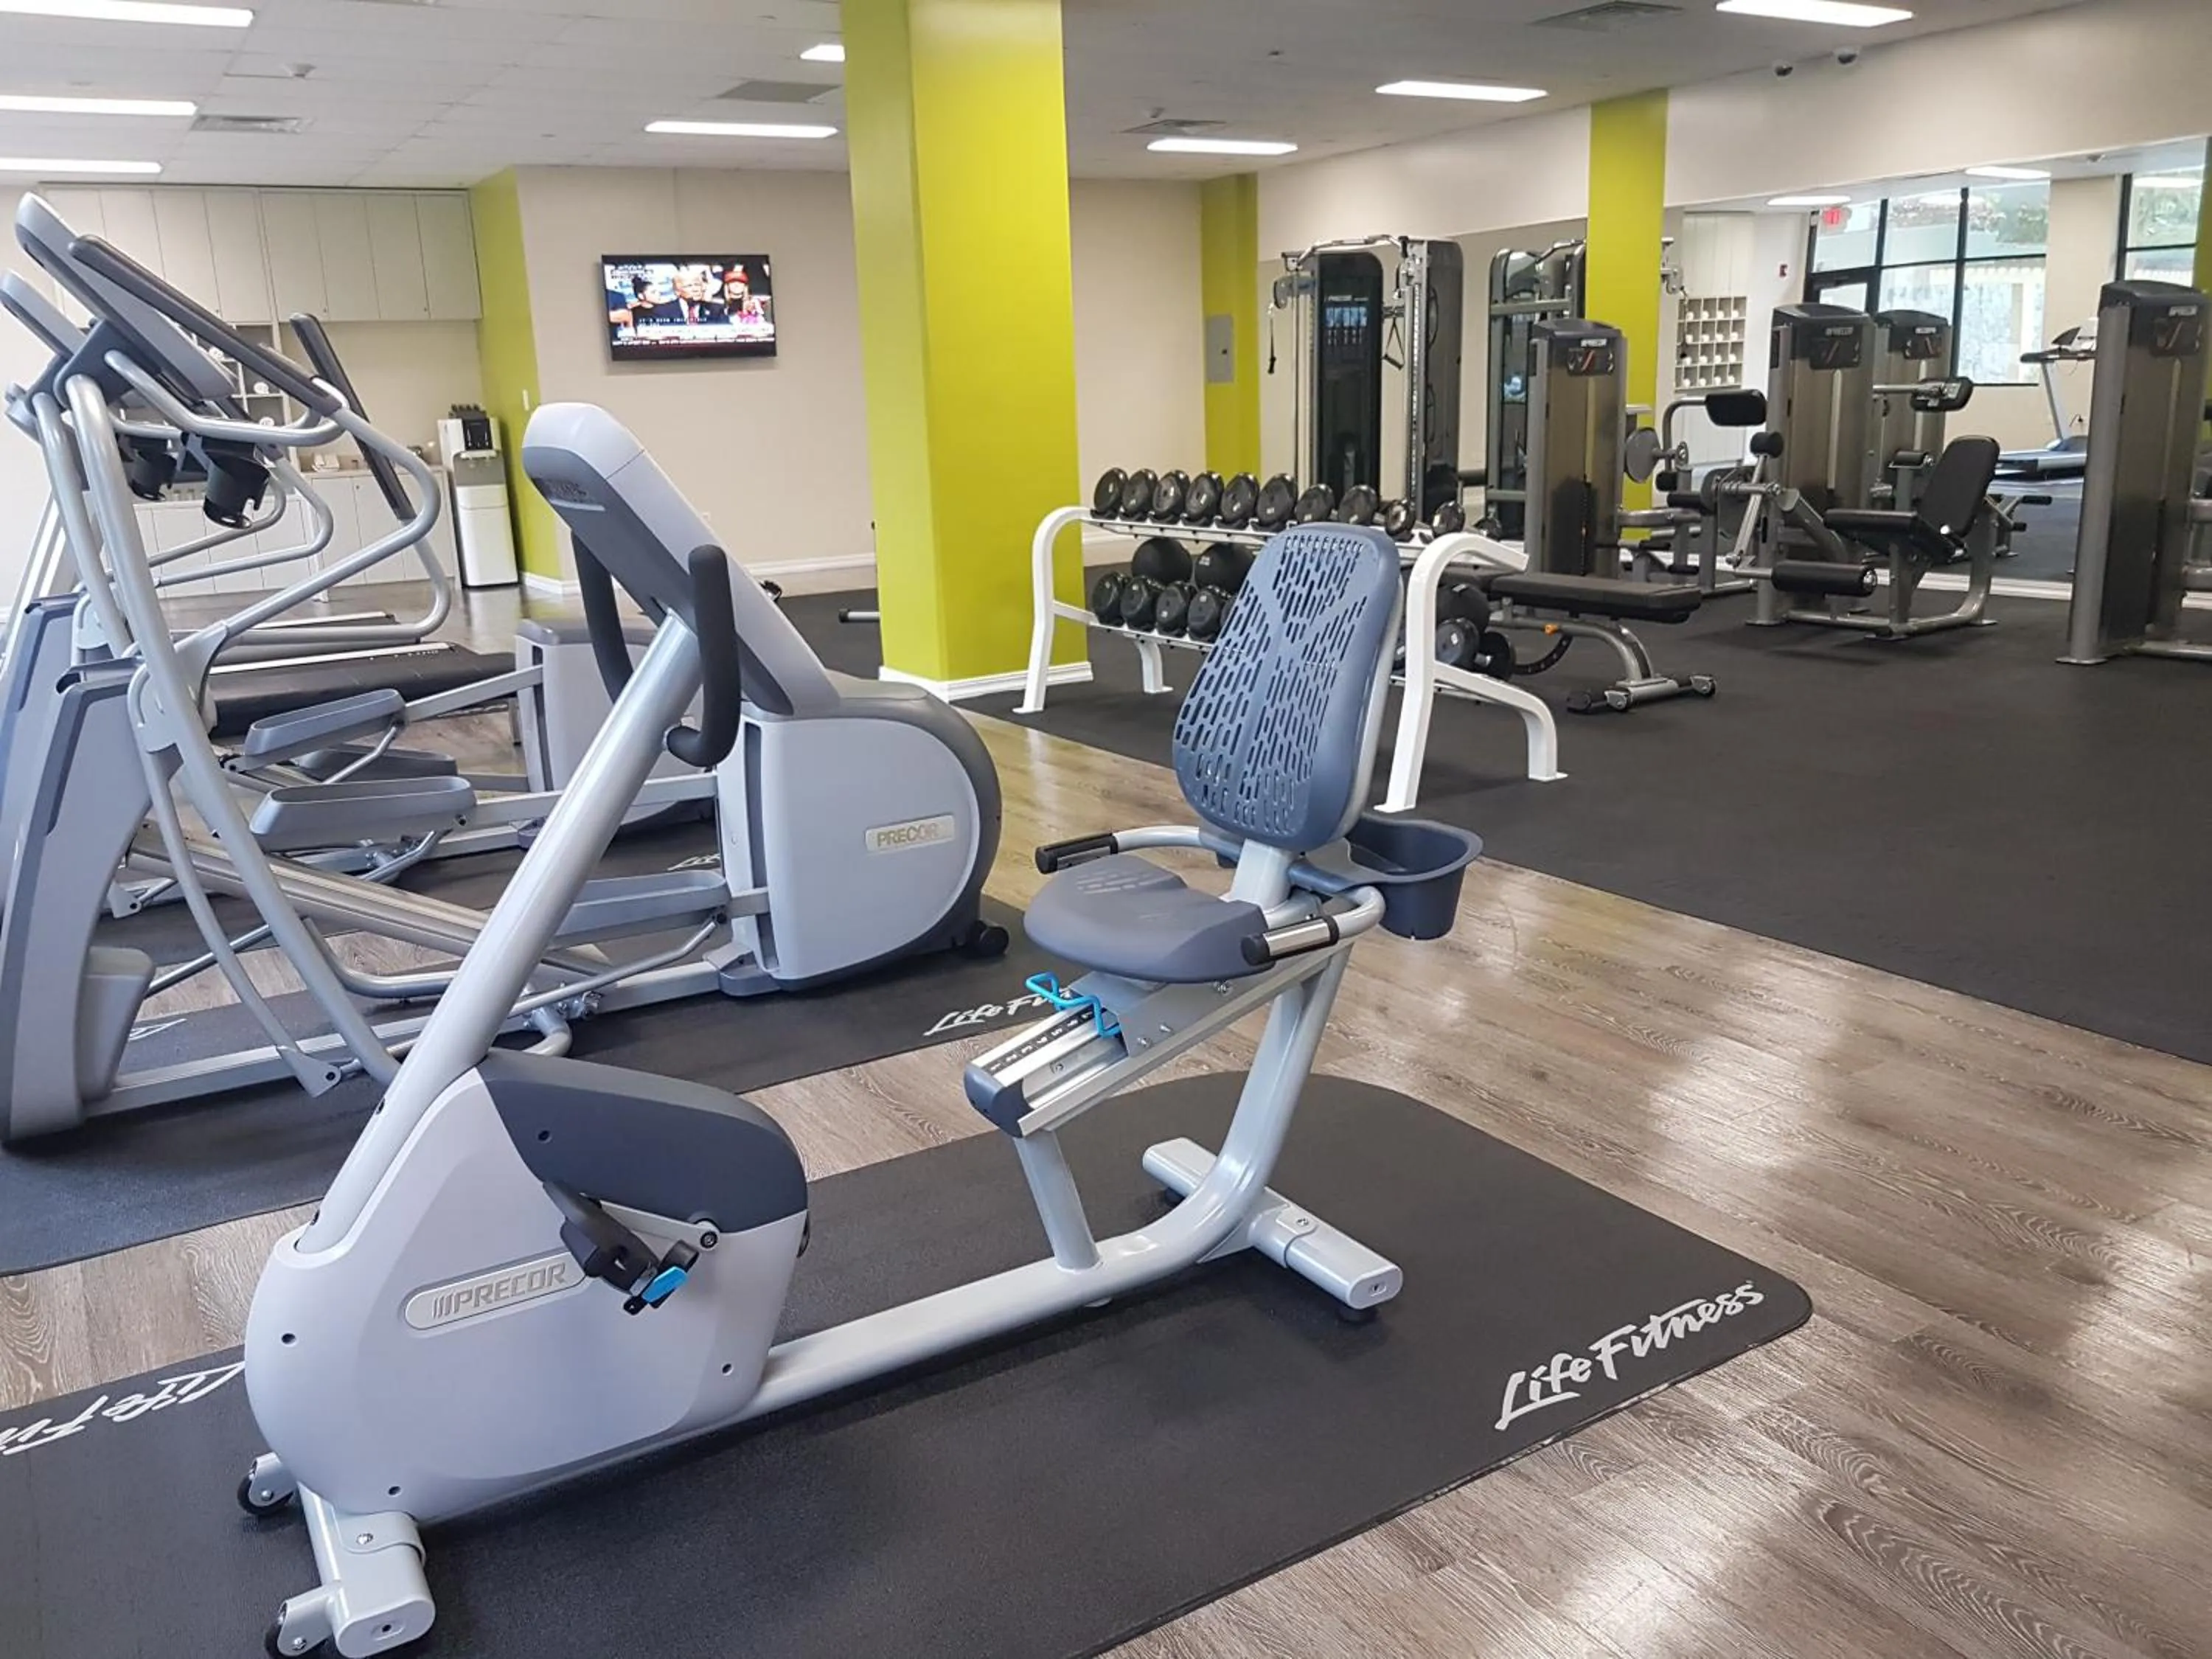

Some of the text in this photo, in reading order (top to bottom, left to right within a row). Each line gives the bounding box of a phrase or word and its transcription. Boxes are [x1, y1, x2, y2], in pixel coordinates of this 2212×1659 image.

[877, 823, 939, 847] PRECOR
[923, 1004, 1004, 1036] Life
[452, 1262, 566, 1315] PRECOR
[1495, 1284, 1764, 1430] Life Fitness
[101, 1361, 245, 1422] Life
